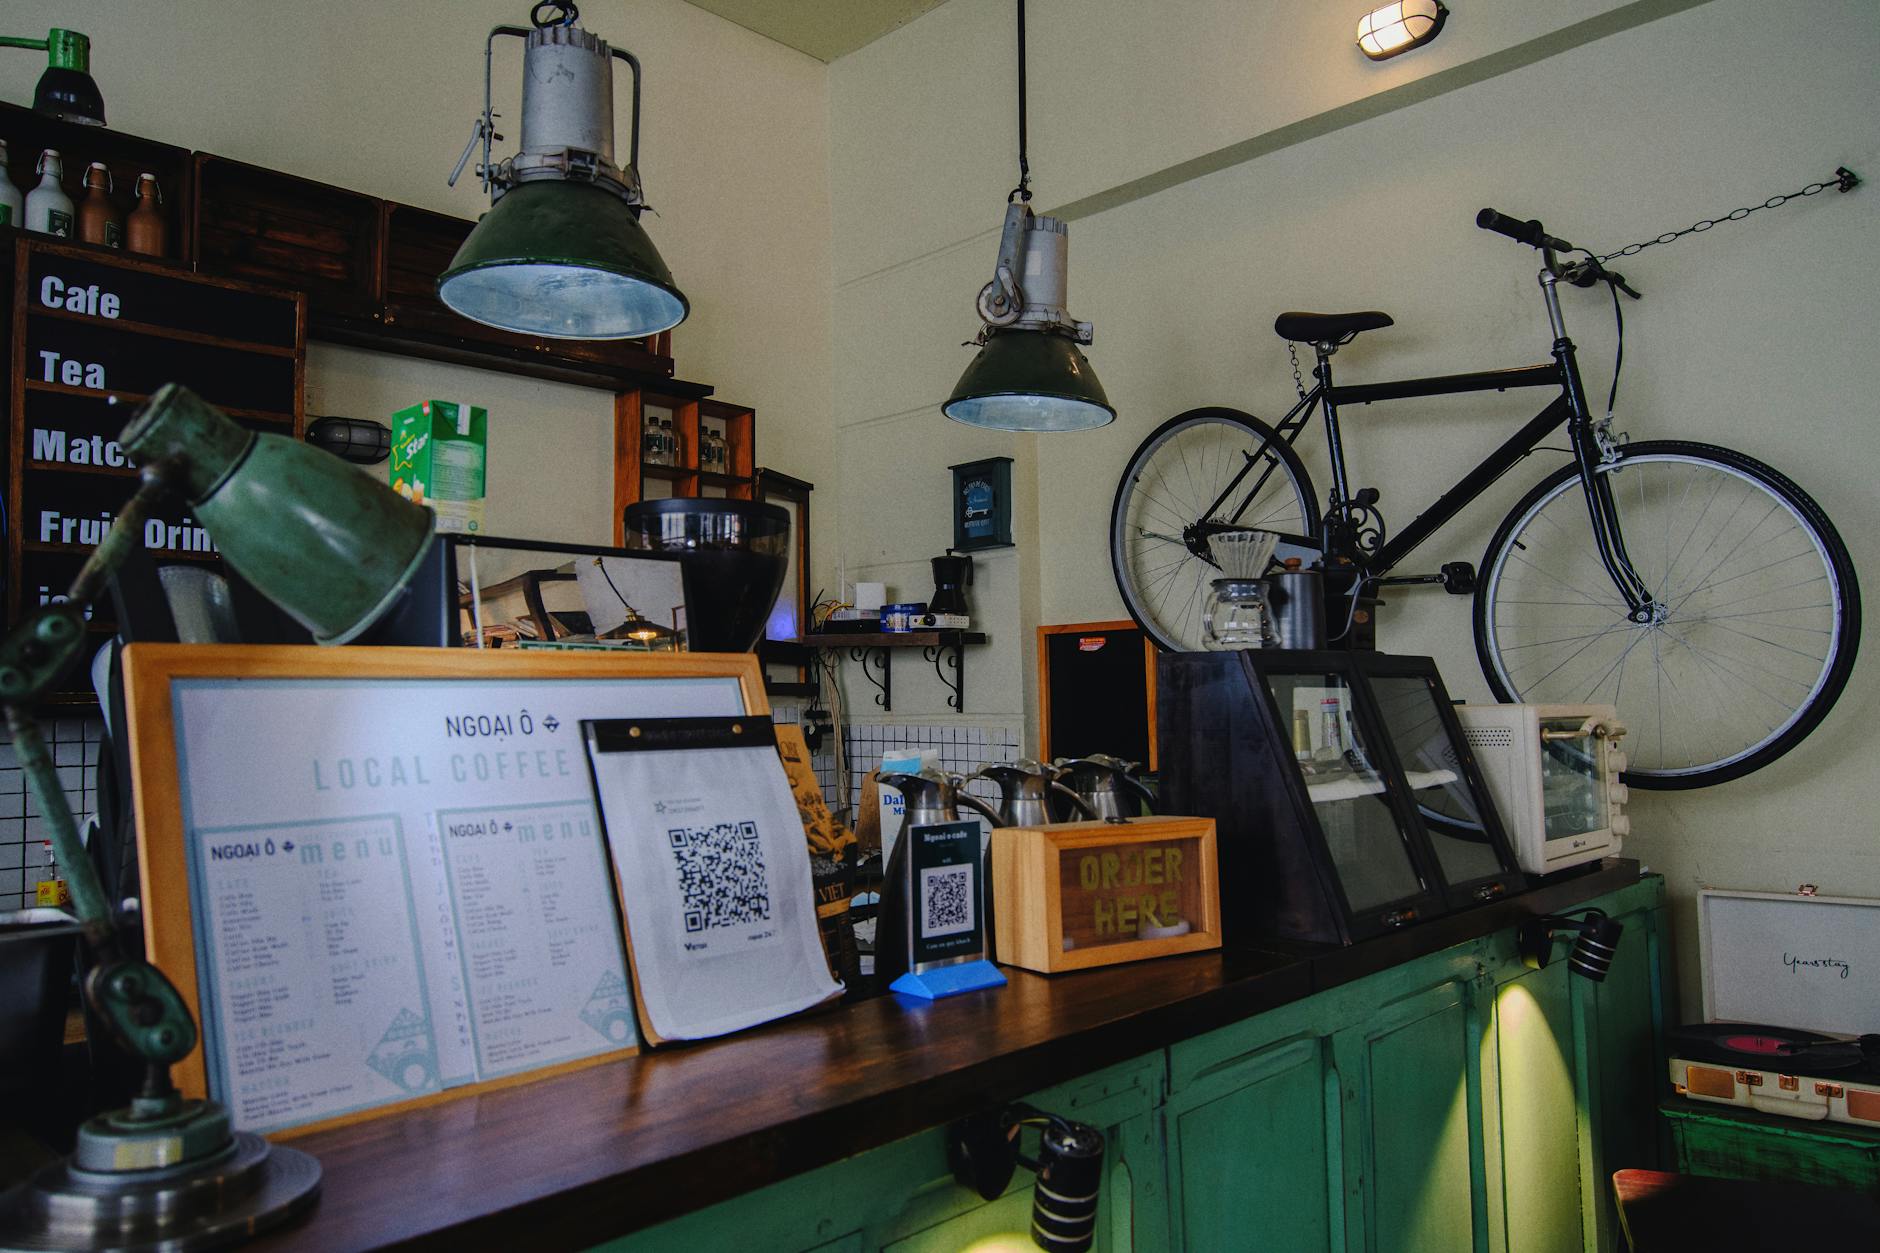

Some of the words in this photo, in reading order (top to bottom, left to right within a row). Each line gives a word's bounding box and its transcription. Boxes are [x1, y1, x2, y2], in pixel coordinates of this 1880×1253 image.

[40, 275, 121, 320] Cafe
[39, 350, 105, 390] Tea
[33, 428, 136, 469] Matc
[144, 518, 219, 553] Drin
[446, 714, 513, 742] NGOẠI
[520, 709, 534, 736] Ô
[313, 755, 431, 791] LOCAL
[451, 749, 571, 783] COFFEE
[300, 837, 394, 865] menu
[517, 819, 592, 844] menu
[1080, 848, 1184, 892] ORDER
[1093, 891, 1180, 936] HERE
